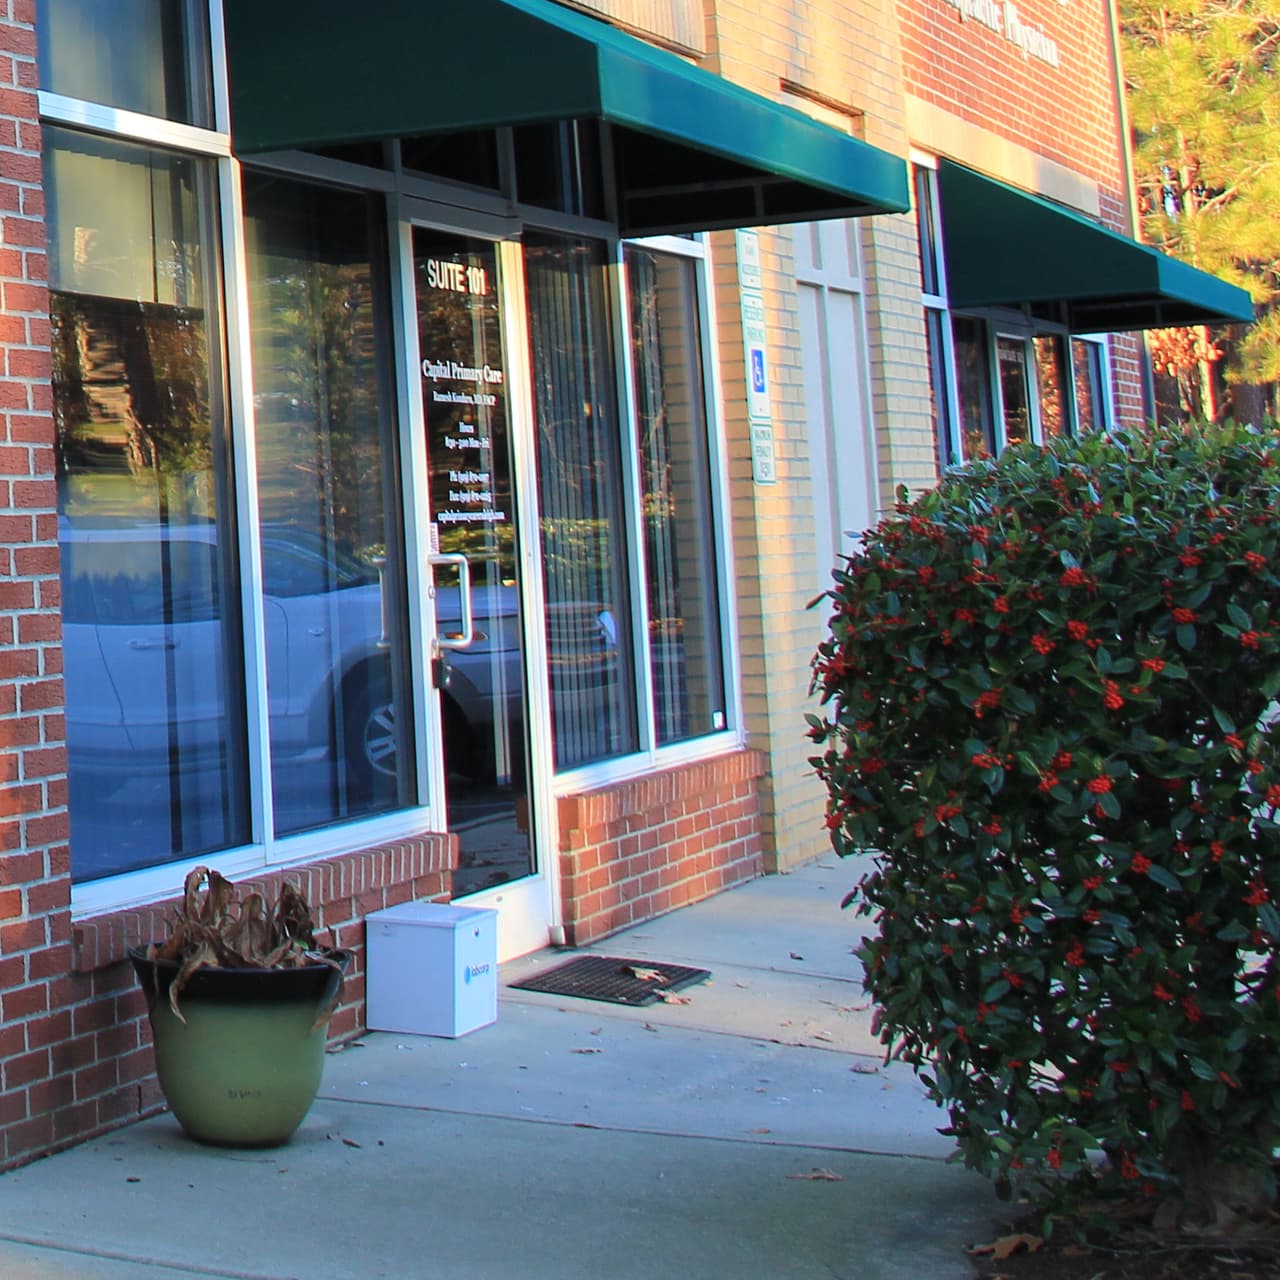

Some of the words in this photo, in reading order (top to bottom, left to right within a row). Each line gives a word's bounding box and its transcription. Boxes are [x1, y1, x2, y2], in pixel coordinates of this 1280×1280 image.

[1002, 0, 1060, 69] Physician
[427, 258, 466, 293] SUITE
[466, 266, 488, 296] 101
[422, 359, 450, 382] Capital
[451, 361, 483, 385] Primary
[483, 364, 503, 384] Care
